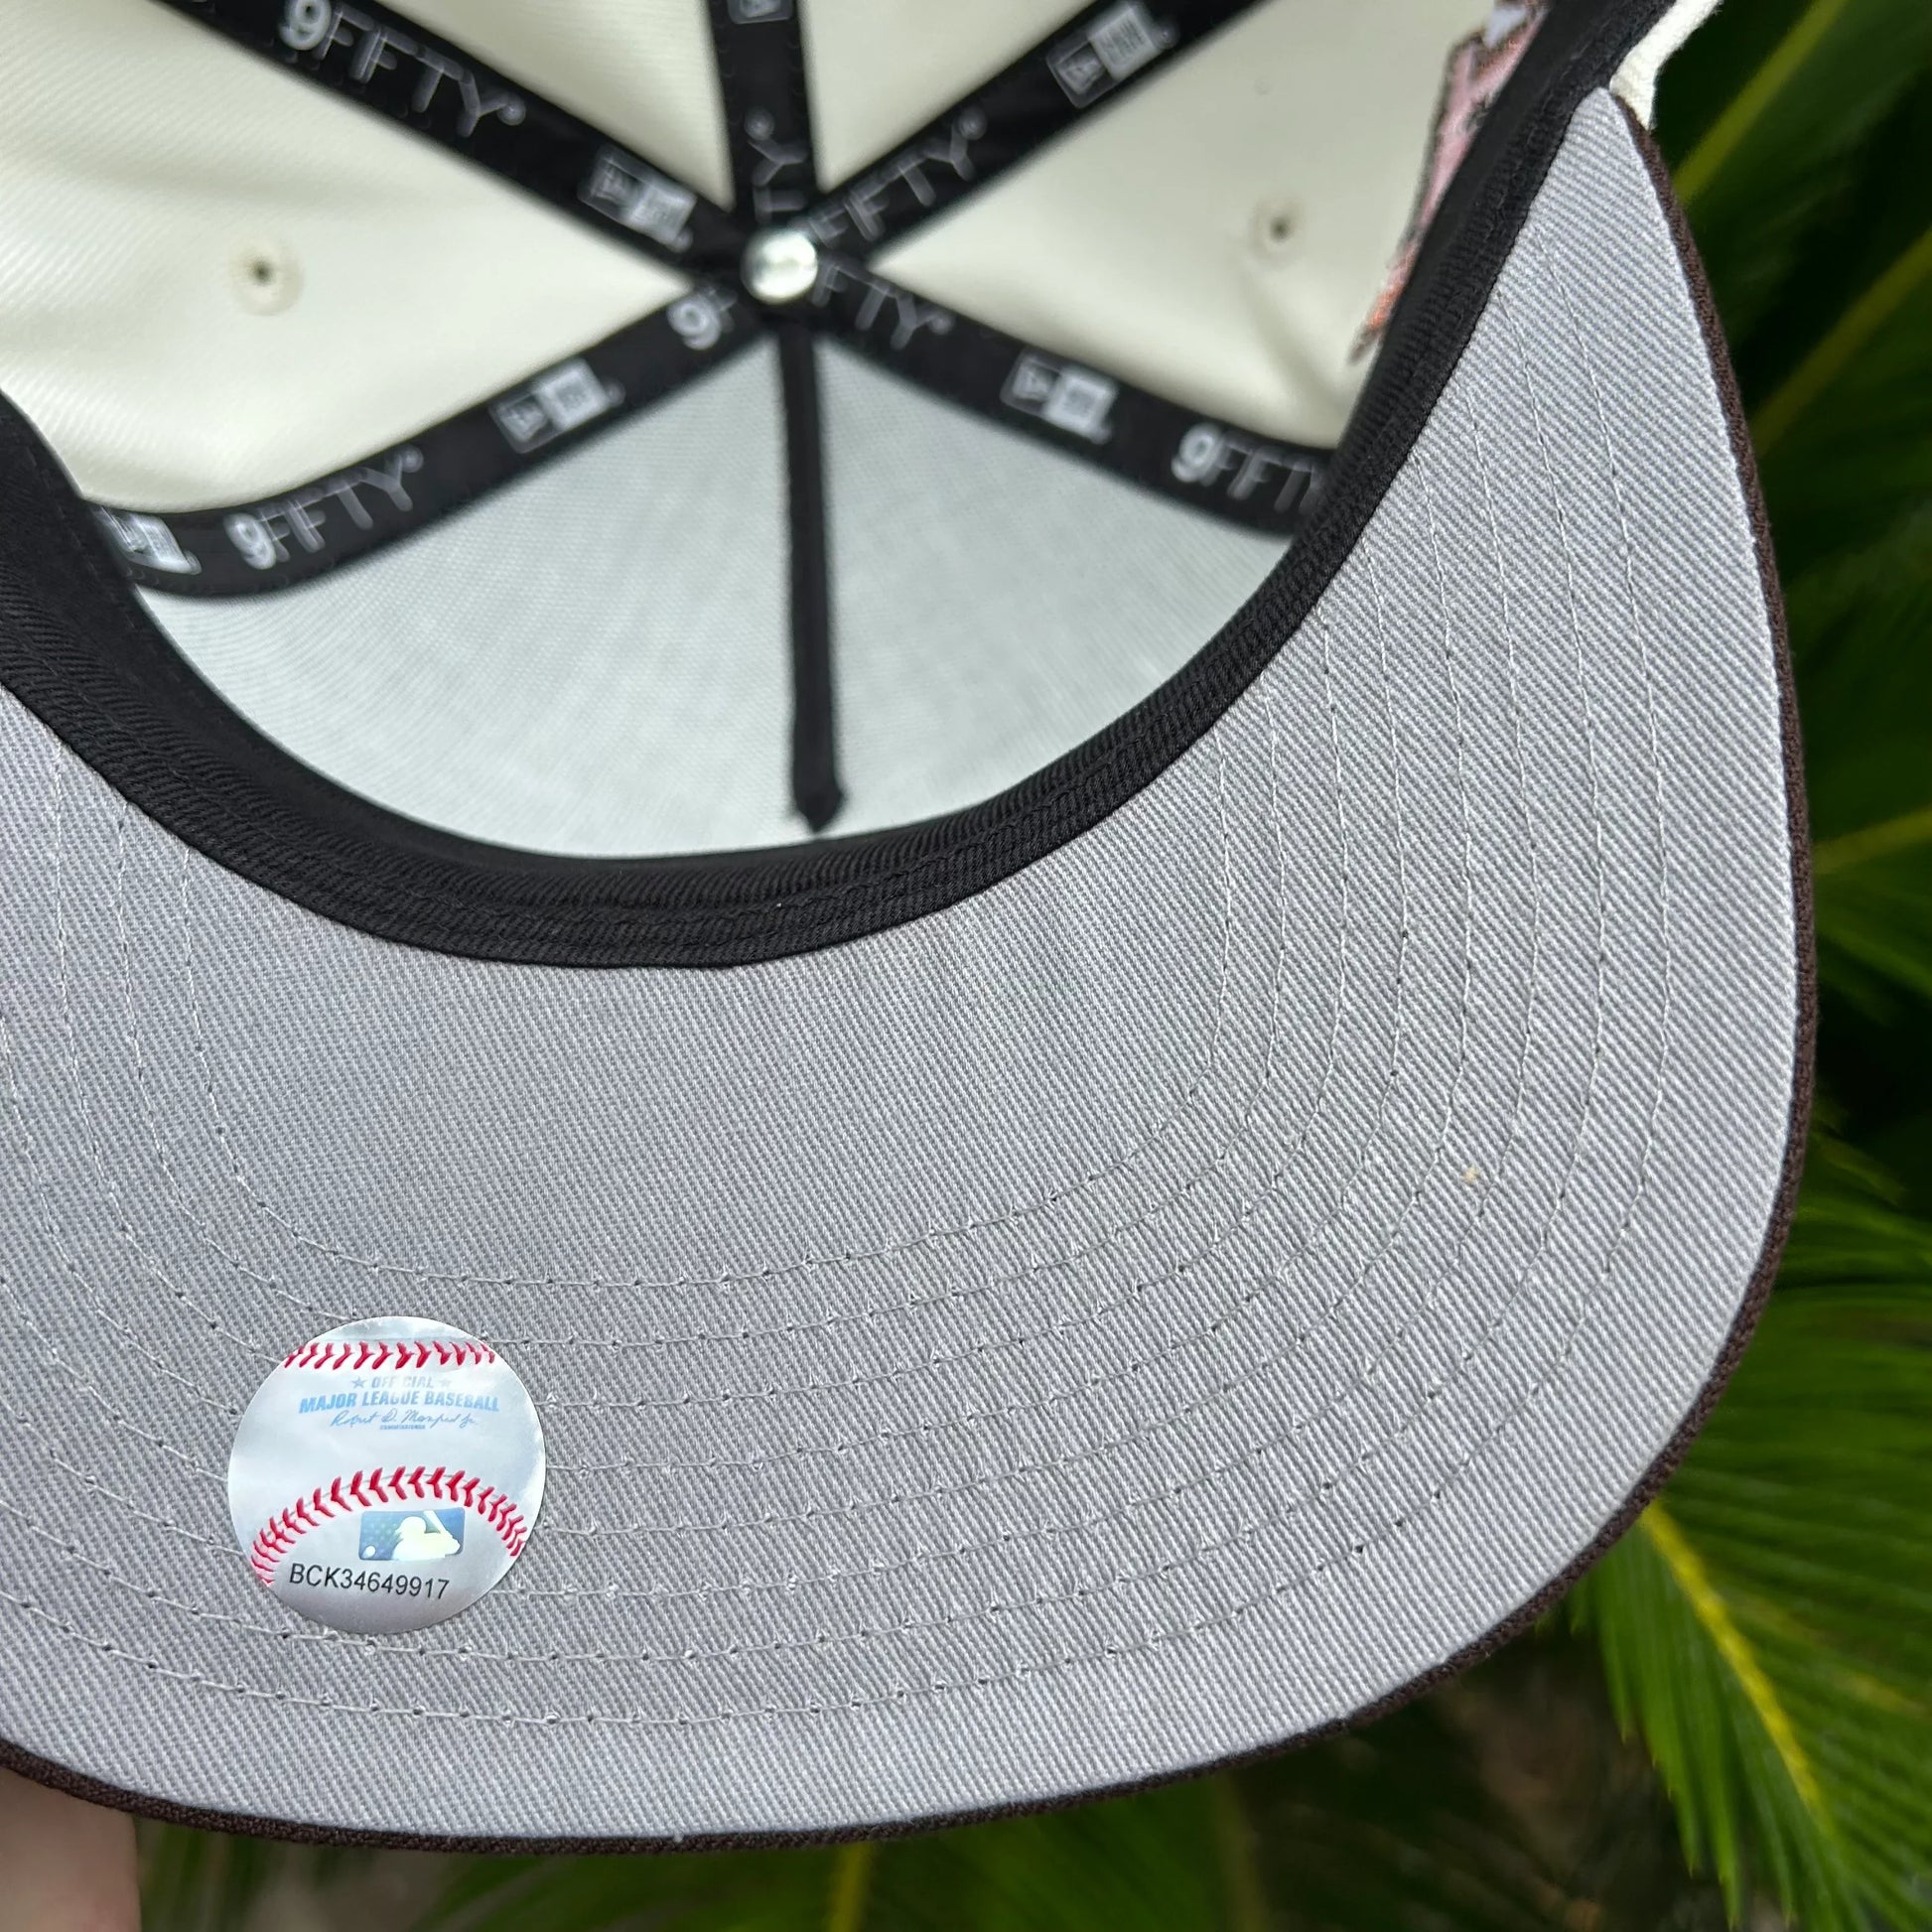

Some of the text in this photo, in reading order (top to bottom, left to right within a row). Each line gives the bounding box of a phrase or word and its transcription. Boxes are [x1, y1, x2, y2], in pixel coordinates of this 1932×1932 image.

[371, 1375, 434, 1390] OFFCIAL
[299, 1390, 500, 1414] MAJOR LEAGUE BASEBALL
[289, 1563, 451, 1600] BCK34649917
